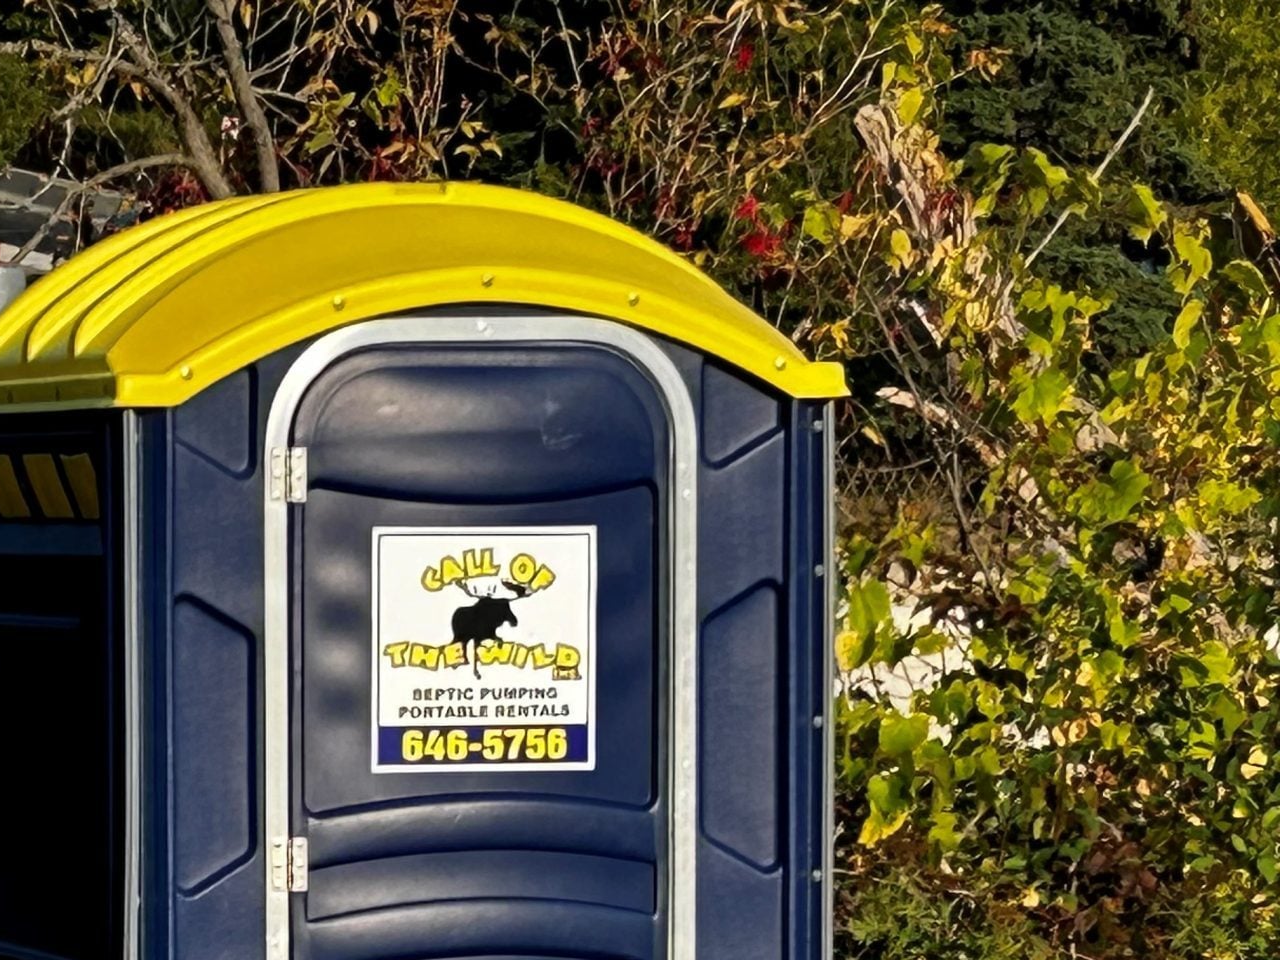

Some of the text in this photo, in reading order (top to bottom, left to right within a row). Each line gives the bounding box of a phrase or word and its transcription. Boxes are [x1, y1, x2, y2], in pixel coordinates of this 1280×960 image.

[421, 547, 556, 593] CALL OF
[383, 638, 581, 671] THE WILD
[412, 687, 558, 701] SEPTIC PUMPING
[398, 704, 570, 719] PORTABLE RENTALS
[401, 728, 568, 762] 646-5756
